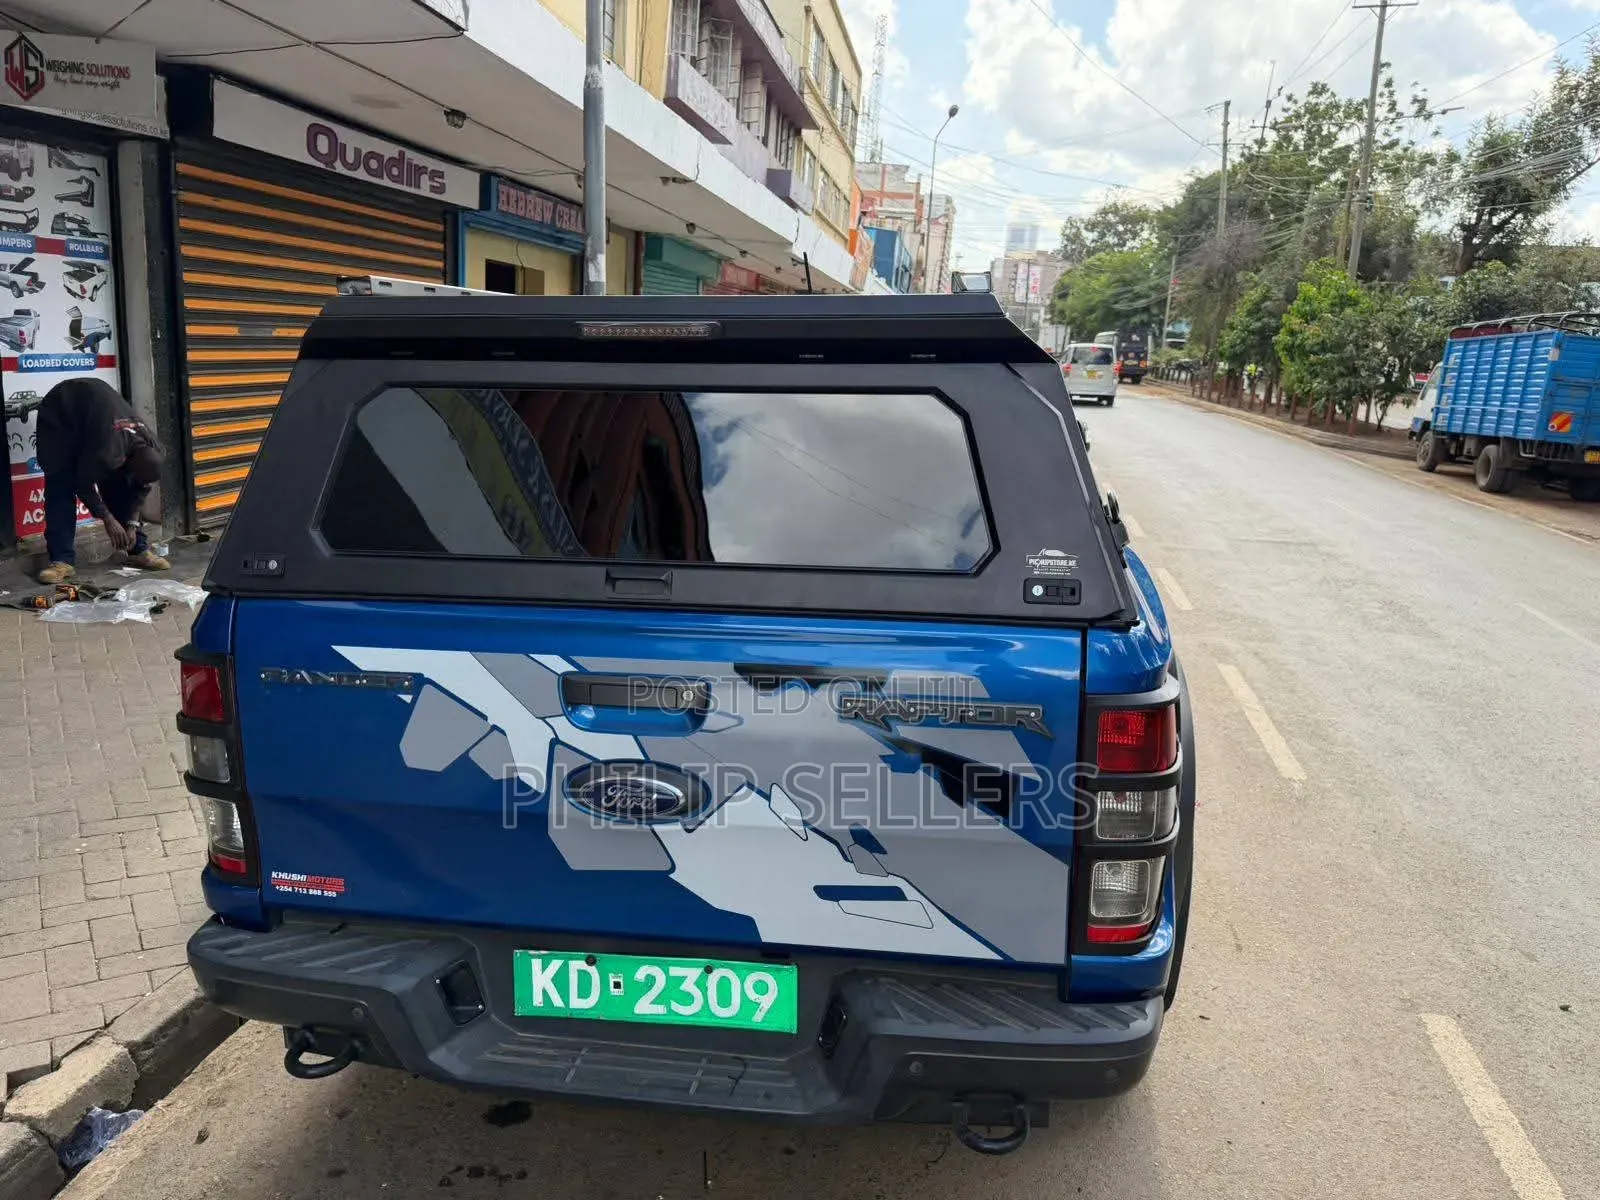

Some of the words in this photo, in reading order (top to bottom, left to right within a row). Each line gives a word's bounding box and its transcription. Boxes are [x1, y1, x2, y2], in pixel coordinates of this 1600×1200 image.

[45, 60, 85, 74] WEIGHING
[86, 64, 130, 79] SOLUTIONS
[306, 122, 446, 195] Quadirs
[0, 237, 32, 249] MPERS
[69, 242, 104, 254] ROLLBARS
[22, 359, 61, 369] LOADBED
[62, 357, 95, 367] COVERS
[841, 695, 1054, 740] RAPTOR
[601, 784, 658, 810] Ford
[271, 871, 307, 882] KHUSHI
[307, 874, 345, 886] MOTORS
[275, 885, 293, 893] +254
[530, 958, 600, 1009] KD
[633, 964, 778, 1023] 2309
